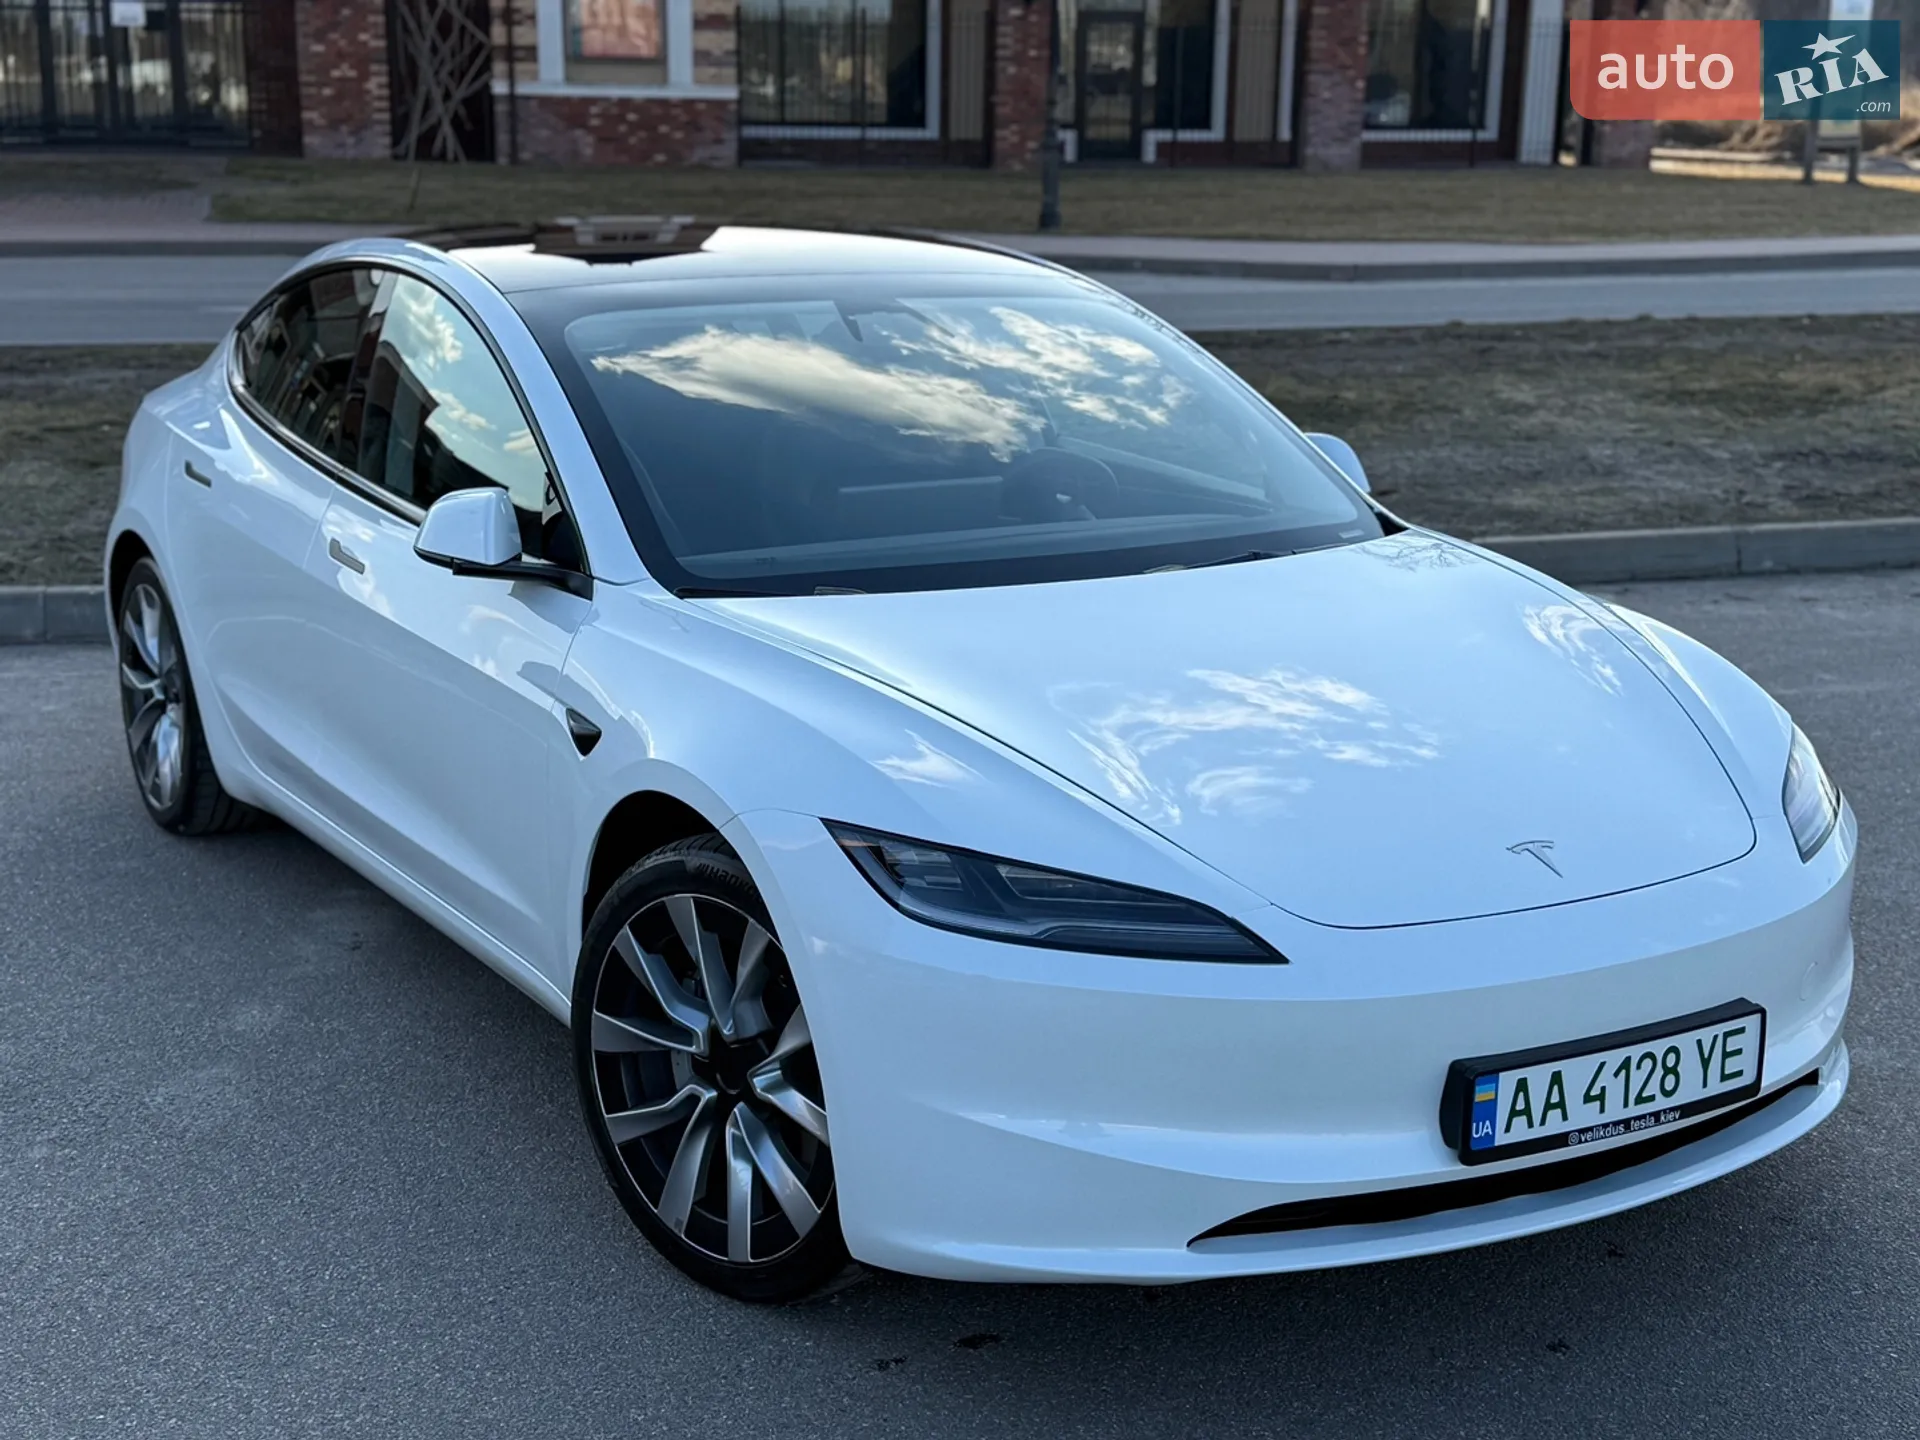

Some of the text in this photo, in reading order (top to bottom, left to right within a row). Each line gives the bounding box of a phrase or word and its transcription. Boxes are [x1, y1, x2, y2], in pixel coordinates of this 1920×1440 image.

[1504, 1025, 1747, 1134] AA 4128 YE
[1472, 1119, 1493, 1139] UA
